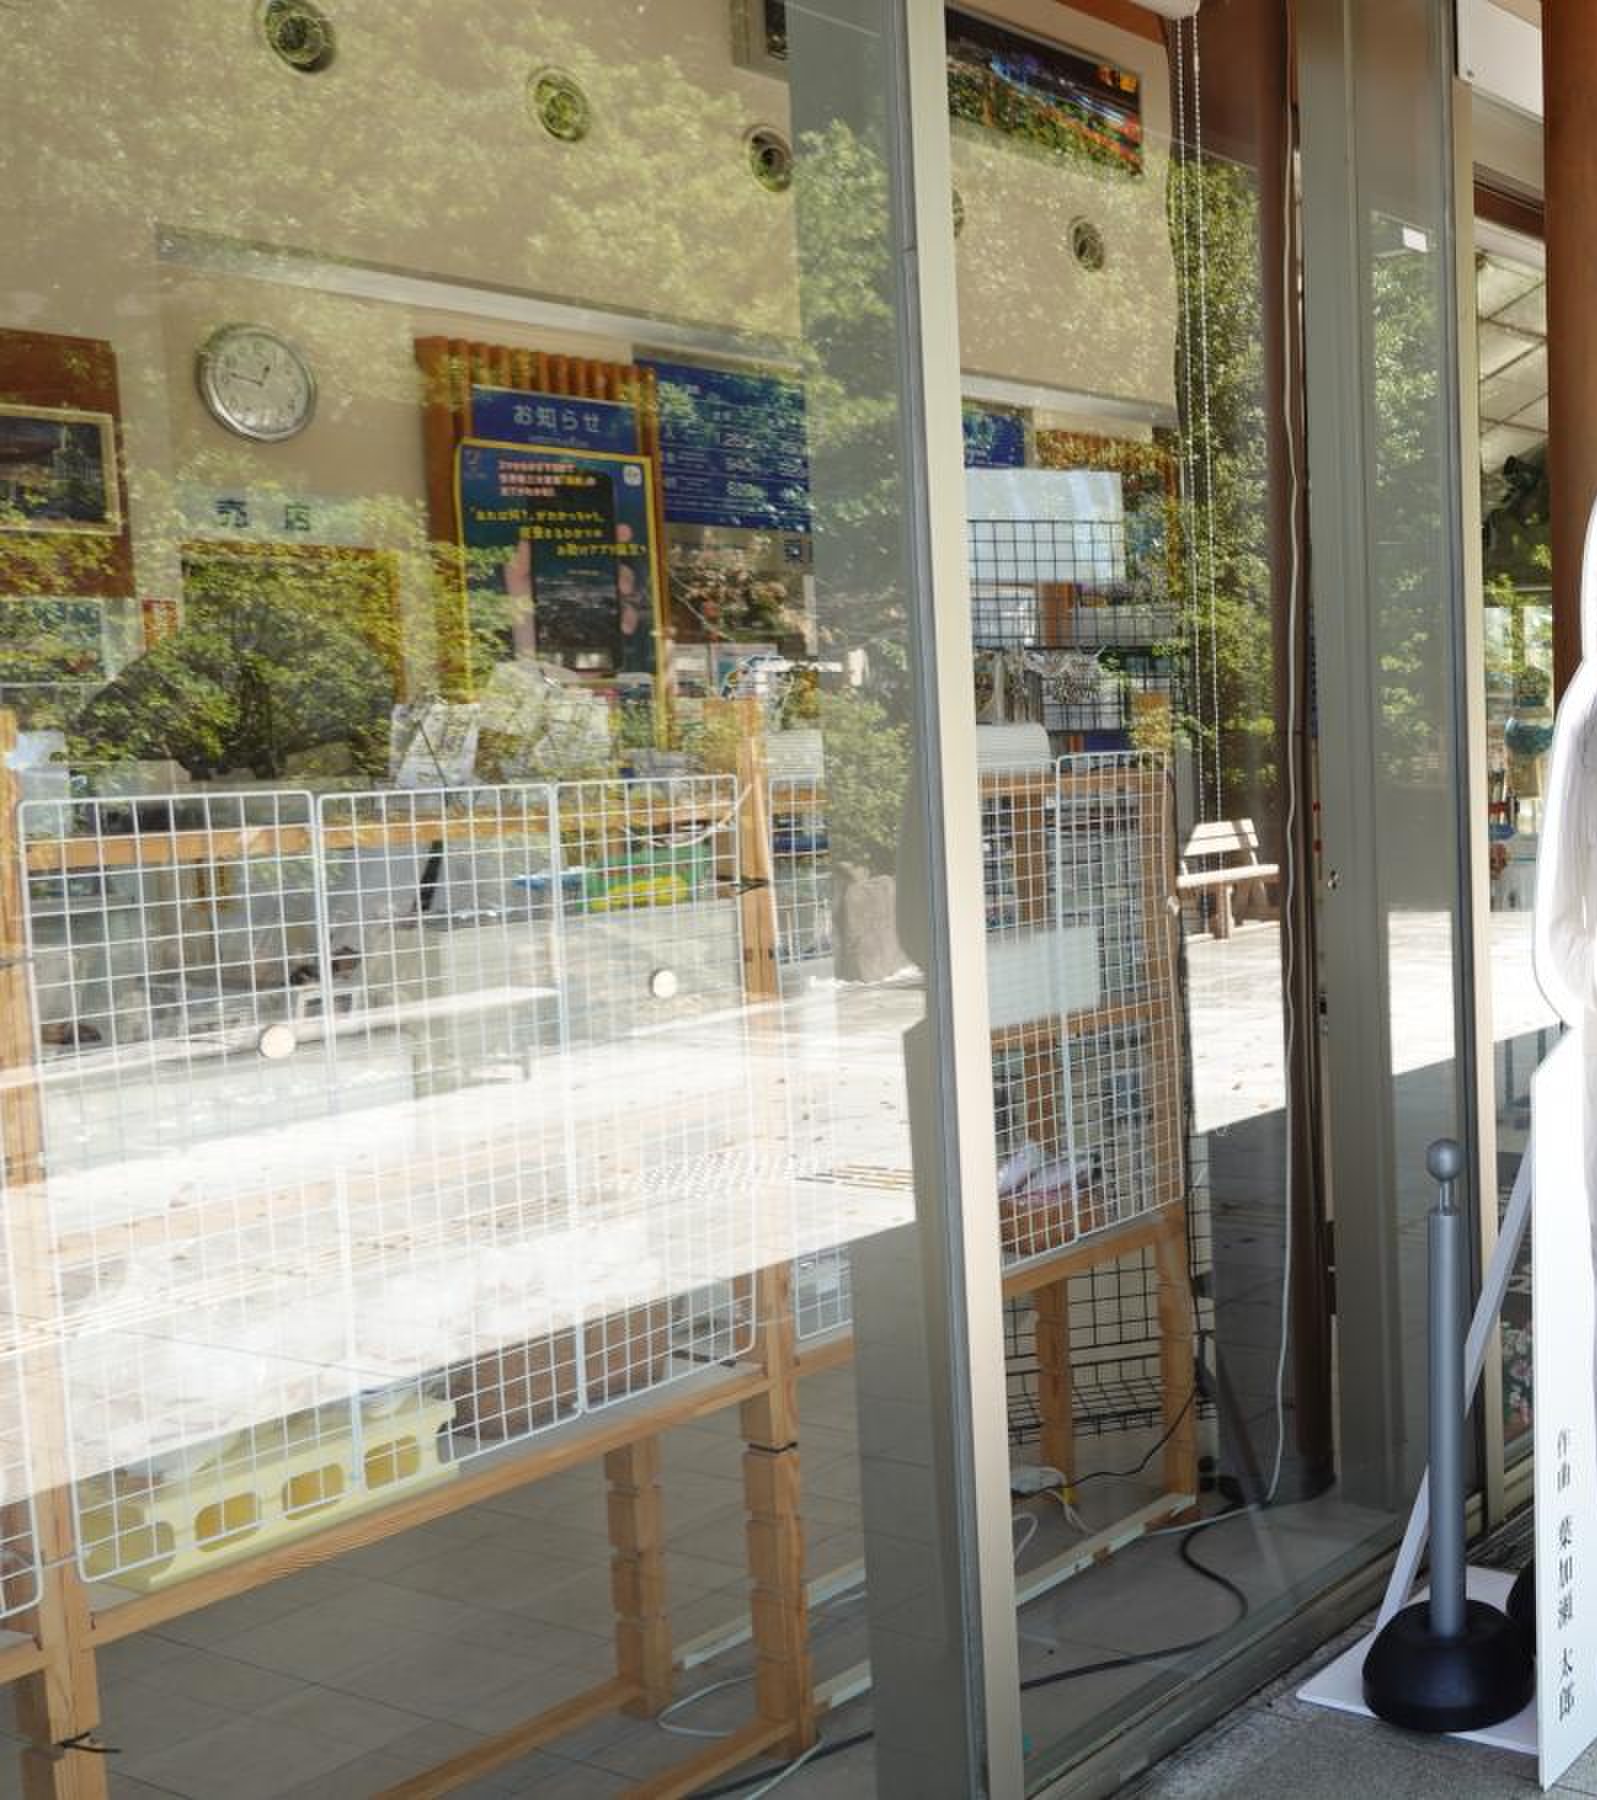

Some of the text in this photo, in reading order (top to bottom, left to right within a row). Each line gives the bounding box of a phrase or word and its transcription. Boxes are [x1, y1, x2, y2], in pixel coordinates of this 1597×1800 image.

[512, 405, 601, 433] お知らせ
[215, 499, 311, 531] 売店
[1556, 1429, 1571, 1493] 作曲
[1557, 1646, 1575, 1723] 太郎
